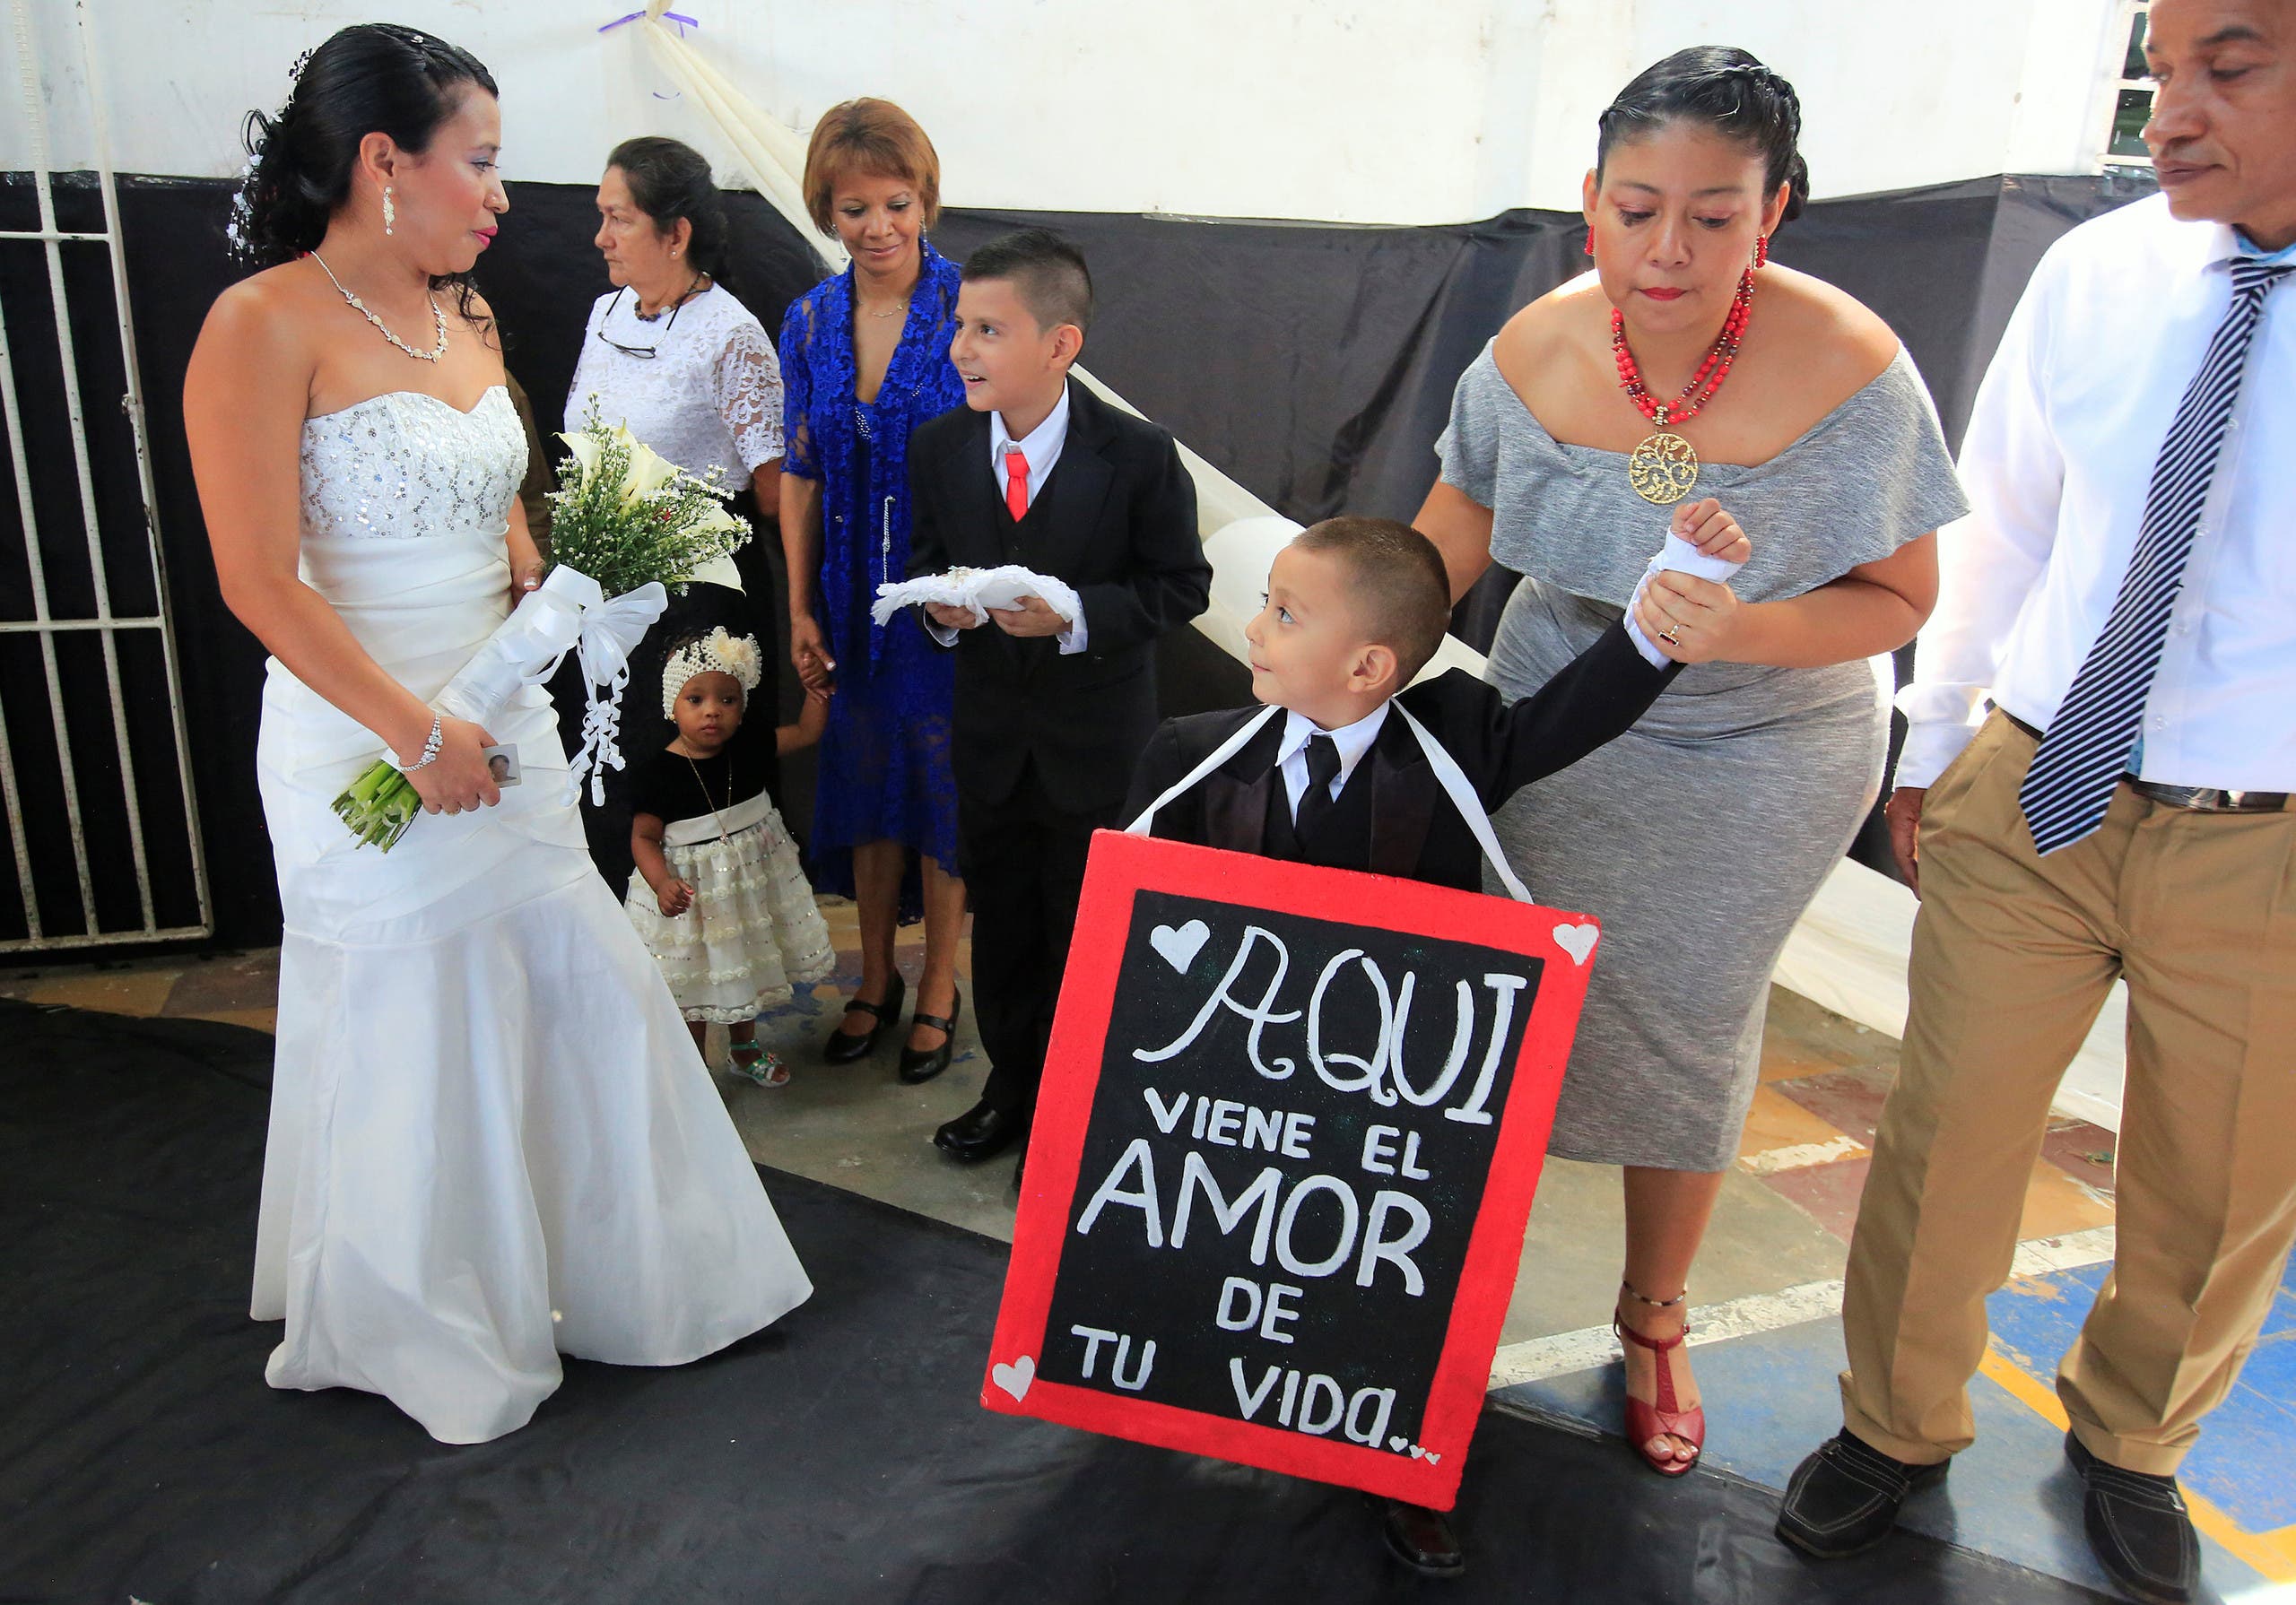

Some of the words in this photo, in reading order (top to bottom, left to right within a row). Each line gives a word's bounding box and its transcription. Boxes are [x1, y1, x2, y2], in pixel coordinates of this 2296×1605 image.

[1132, 924, 1528, 1125] AQUI
[1143, 1087, 1316, 1159] VIENE
[1361, 1124, 1431, 1181] EL
[1076, 1138, 1431, 1297] AMOR
[1070, 1323, 1157, 1391] TU
[1215, 1276, 1304, 1344] DE
